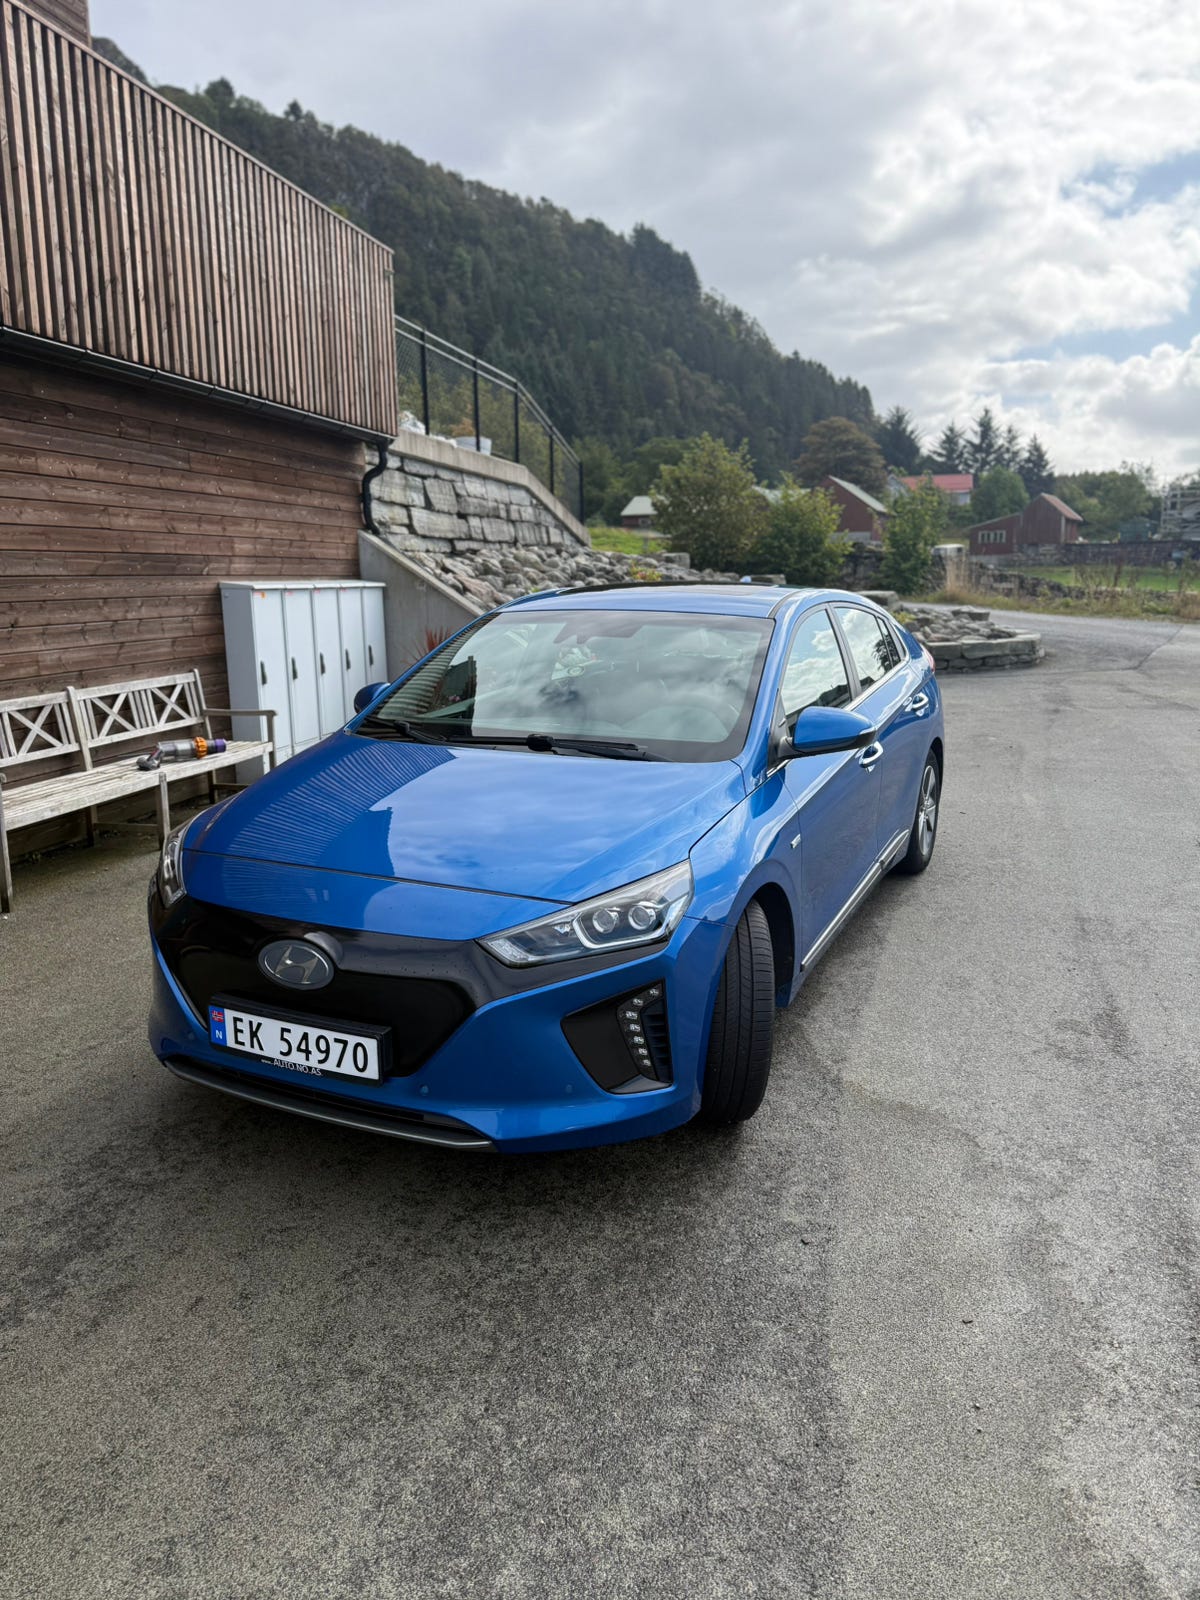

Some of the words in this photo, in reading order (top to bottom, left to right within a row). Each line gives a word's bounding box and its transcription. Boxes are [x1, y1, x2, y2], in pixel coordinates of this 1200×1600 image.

[215, 1029, 223, 1040] N
[232, 1016, 265, 1051] EK
[279, 1027, 369, 1073] 54970
